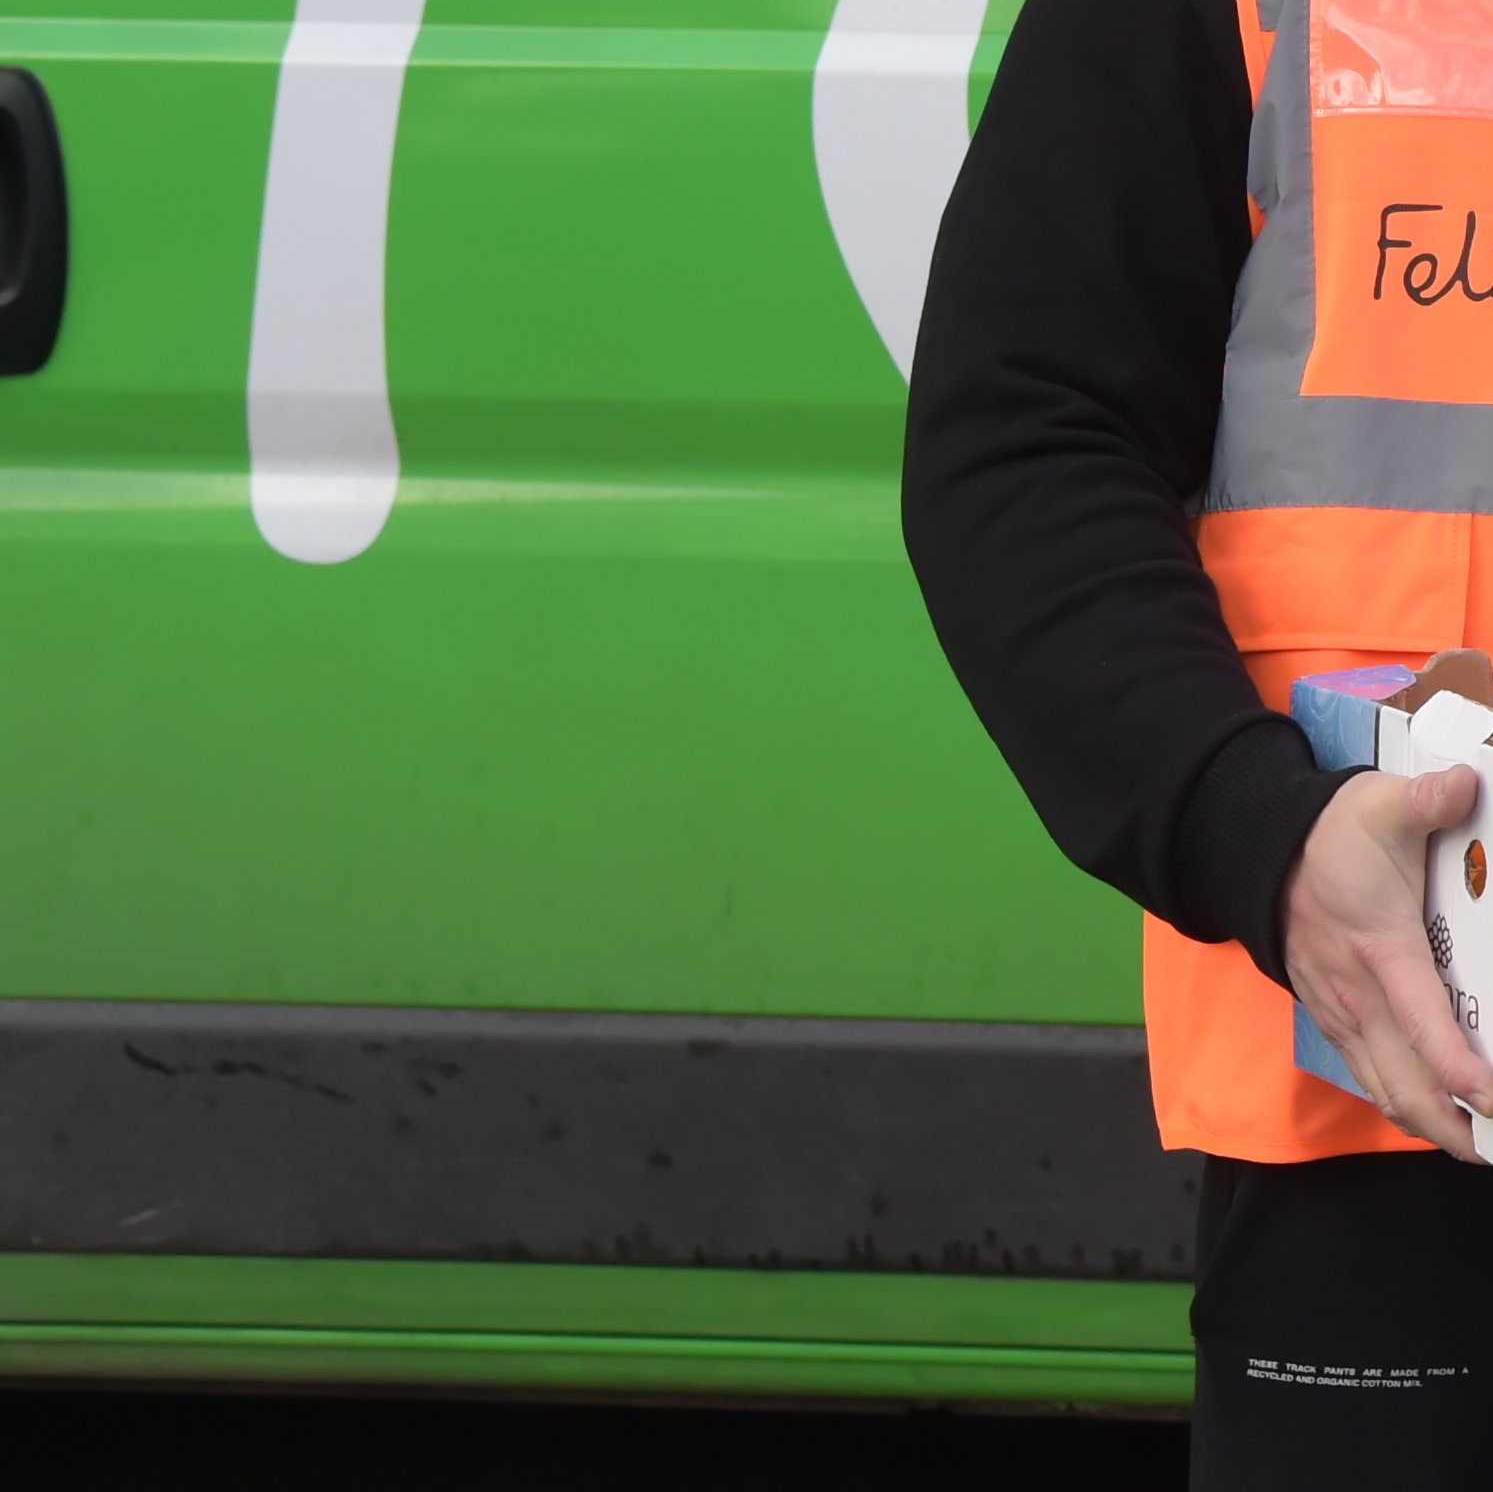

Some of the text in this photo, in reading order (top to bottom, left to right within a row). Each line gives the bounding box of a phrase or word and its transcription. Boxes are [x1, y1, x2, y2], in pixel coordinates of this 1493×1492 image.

[1248, 1358, 1279, 1370] THESE
[1285, 1363, 1317, 1374] TRACK
[1323, 1366, 1357, 1376] PANTS
[1362, 1369, 1383, 1377] ARE
[1390, 1369, 1420, 1377] MADE
[1426, 1367, 1456, 1377] FROM
[1246, 1368, 1295, 1382] RECYCLED
[1361, 1379, 1402, 1388] COTTON
